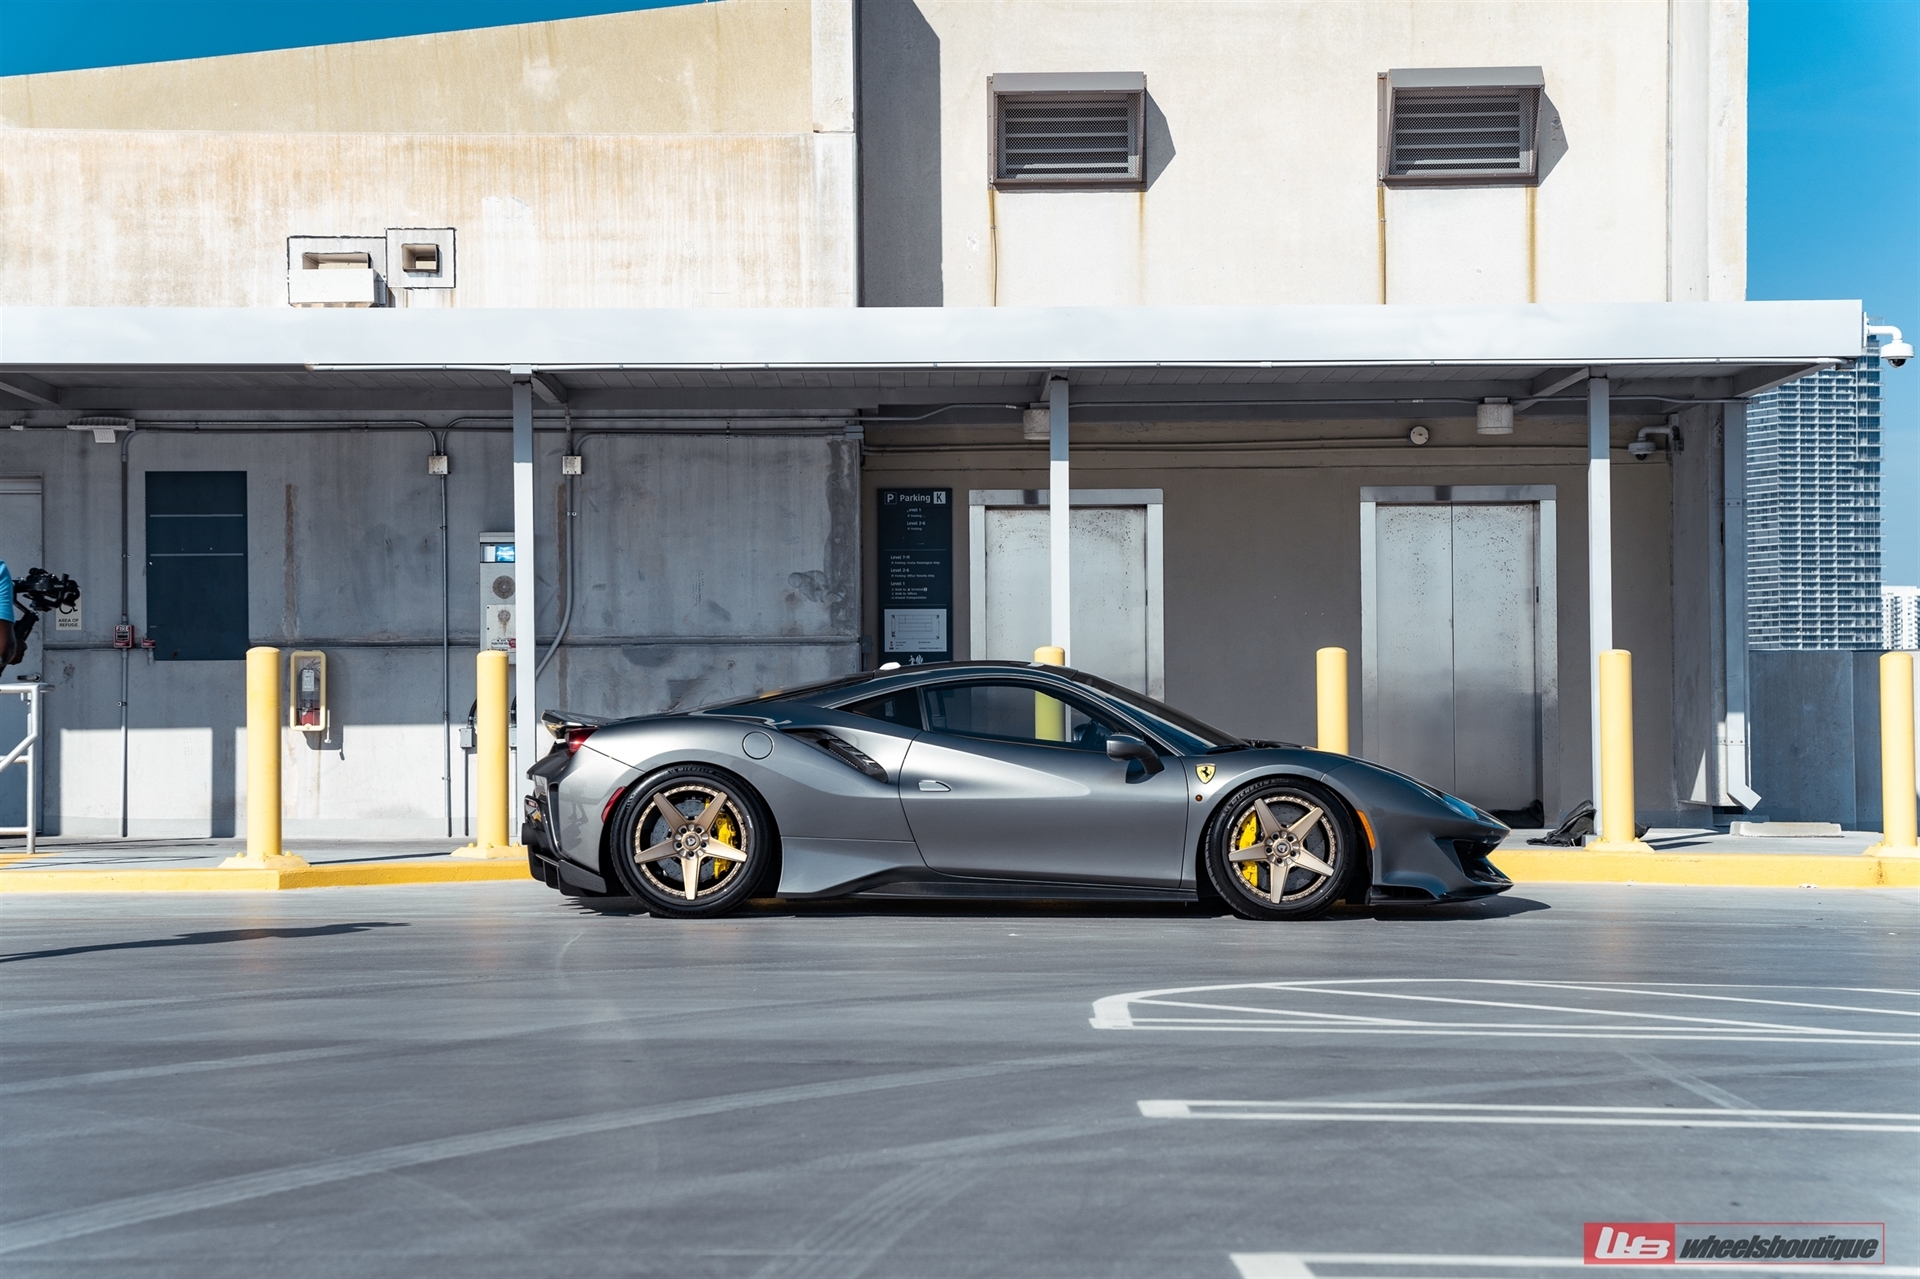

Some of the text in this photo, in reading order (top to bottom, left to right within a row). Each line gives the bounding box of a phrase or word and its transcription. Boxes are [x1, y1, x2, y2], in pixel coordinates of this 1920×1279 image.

[887, 494, 894, 503] P
[900, 494, 931, 504] Parking
[1231, 780, 1270, 806] MICHELIN
